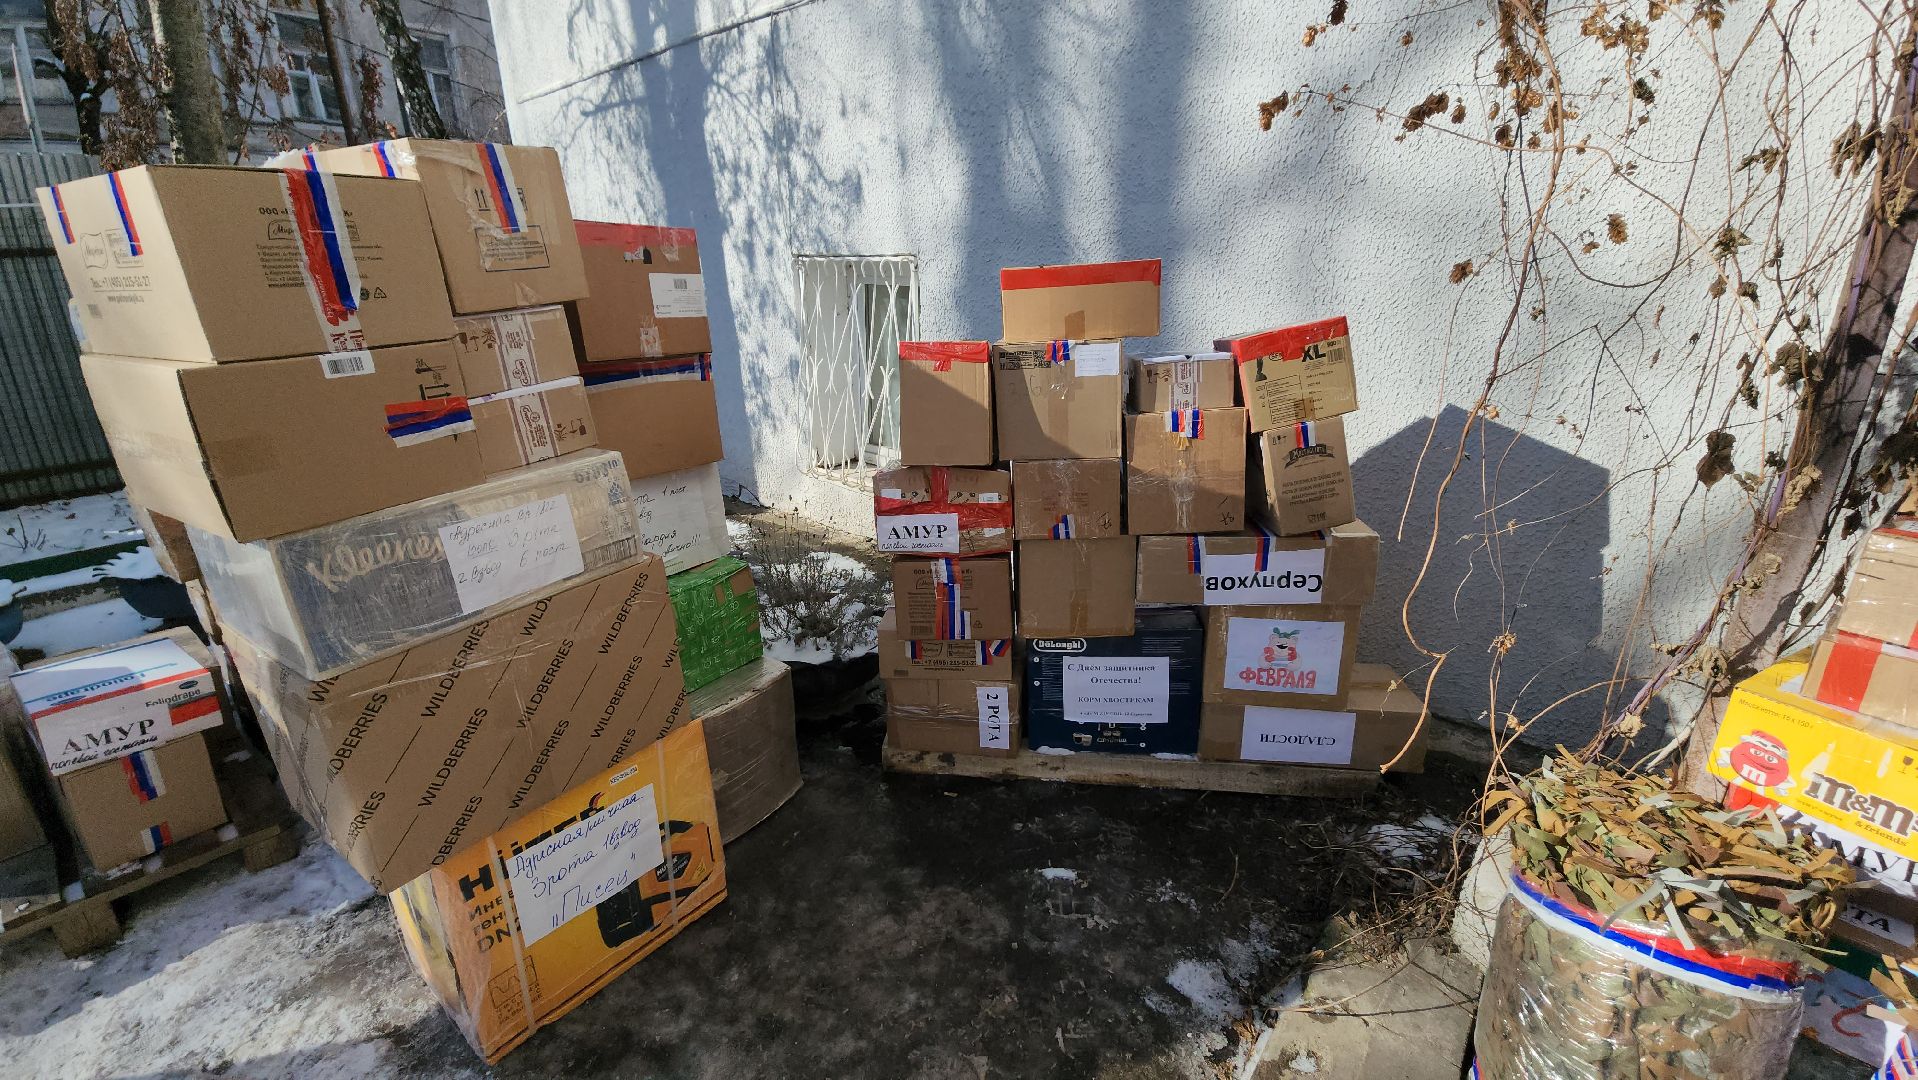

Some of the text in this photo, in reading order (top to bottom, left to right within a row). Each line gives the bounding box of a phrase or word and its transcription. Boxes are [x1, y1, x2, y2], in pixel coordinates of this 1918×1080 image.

[1302, 344, 1327, 362] XL
[888, 525, 948, 539] АМУР
[1205, 571, 1322, 592] Серпухов
[520, 596, 552, 637] WILD
[599, 572, 649, 655] WILDBERRIES
[516, 639, 574, 731] WILDBERRIES
[1076, 663, 1101, 672] Днём
[1090, 676, 1142, 684] Отечества!
[1239, 667, 1317, 689] ФЕВРАЛЯ
[590, 655, 643, 740] WILDBERRIES
[62, 719, 155, 756] АМУР
[987, 705, 1001, 742] РОТА
[1259, 733, 1336, 746] СЛАДОСТИ
[418, 707, 488, 809] WILDBERRIES
[508, 718, 570, 810] WILDBERRIES
[1803, 772, 1918, 837] m&m
[432, 795, 483, 867] DBERRIES
[1863, 821, 1909, 847] friends
